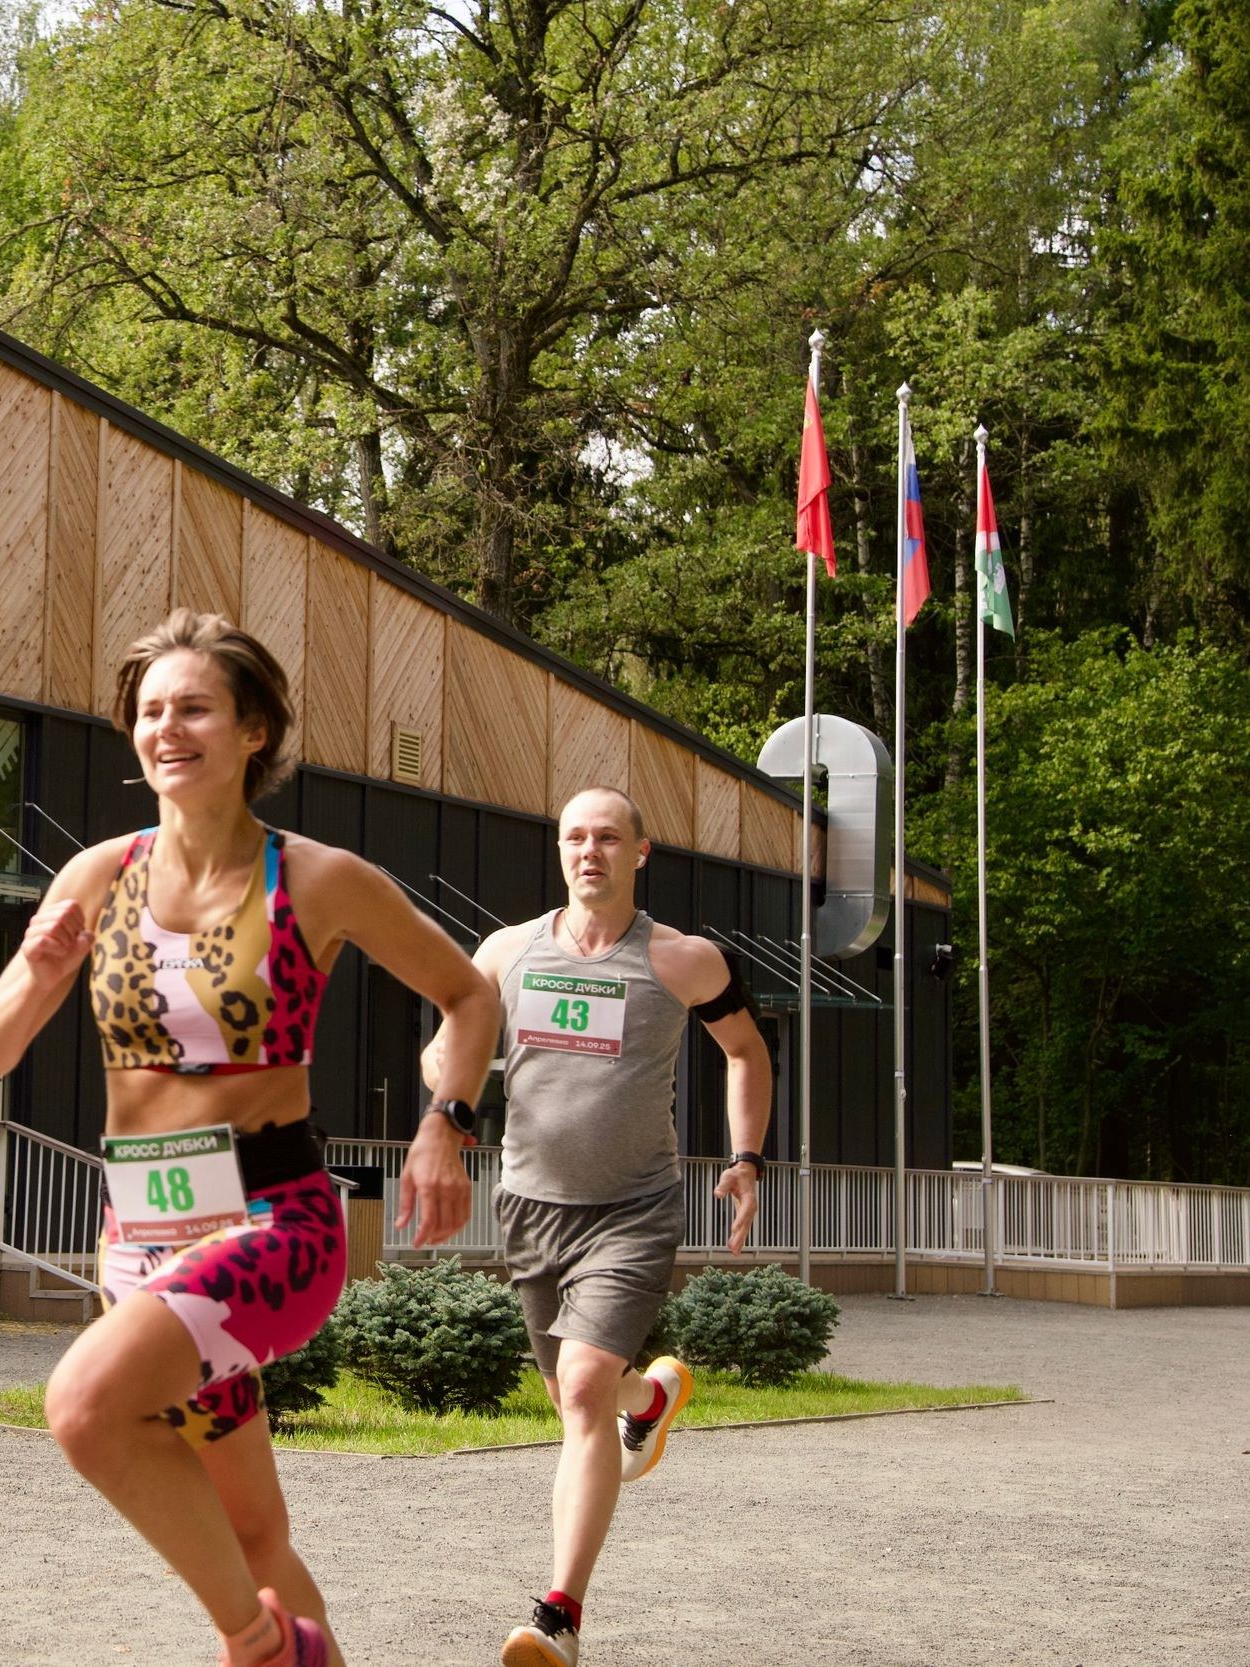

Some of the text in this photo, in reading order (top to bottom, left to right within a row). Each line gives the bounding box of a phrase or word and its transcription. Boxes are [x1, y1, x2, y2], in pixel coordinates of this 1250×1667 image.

[532, 978, 616, 995] КРОСС ДУБКИ
[550, 998, 590, 1032] 43
[575, 1040, 611, 1050] 14.09.25
[114, 1135, 218, 1158] КРОСС ДУБКИ
[147, 1166, 195, 1213] 48
